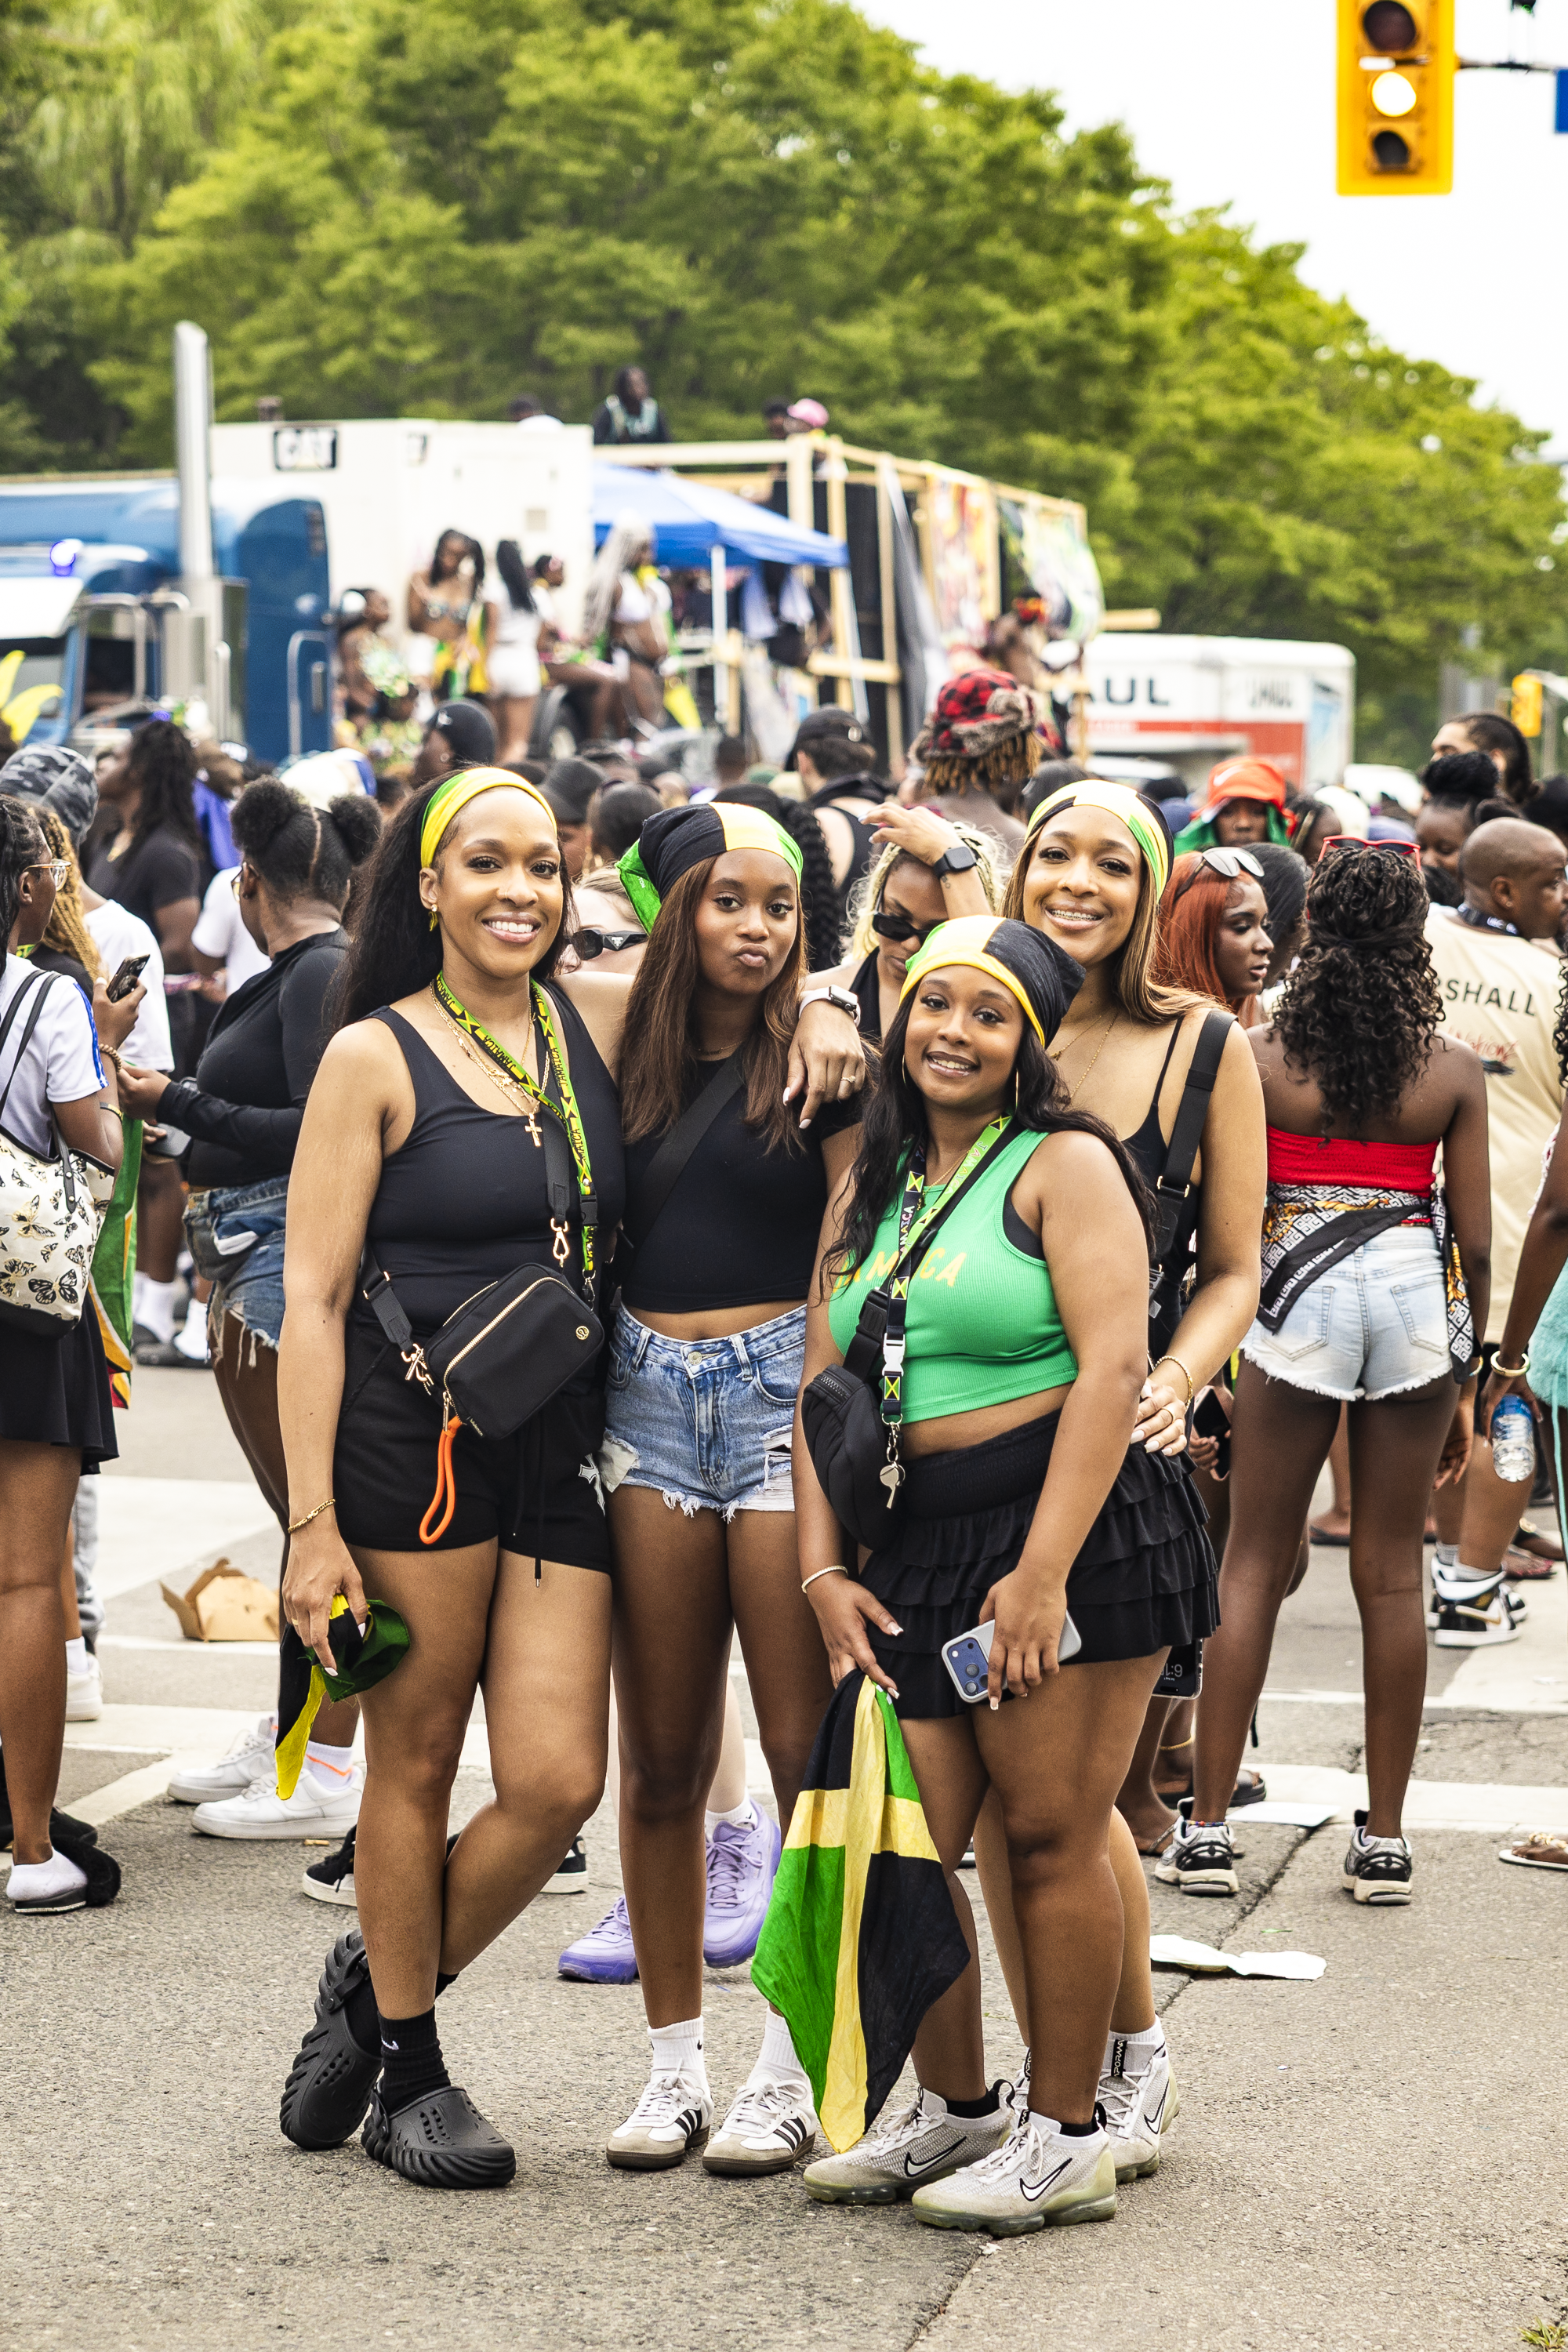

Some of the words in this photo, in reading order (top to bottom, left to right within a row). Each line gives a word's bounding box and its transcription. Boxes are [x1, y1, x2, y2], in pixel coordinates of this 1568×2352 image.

[480, 1035, 517, 1073] JAMAICA
[549, 1047, 568, 1087] JAMAICA
[944, 1142, 988, 1195] JAMAICA
